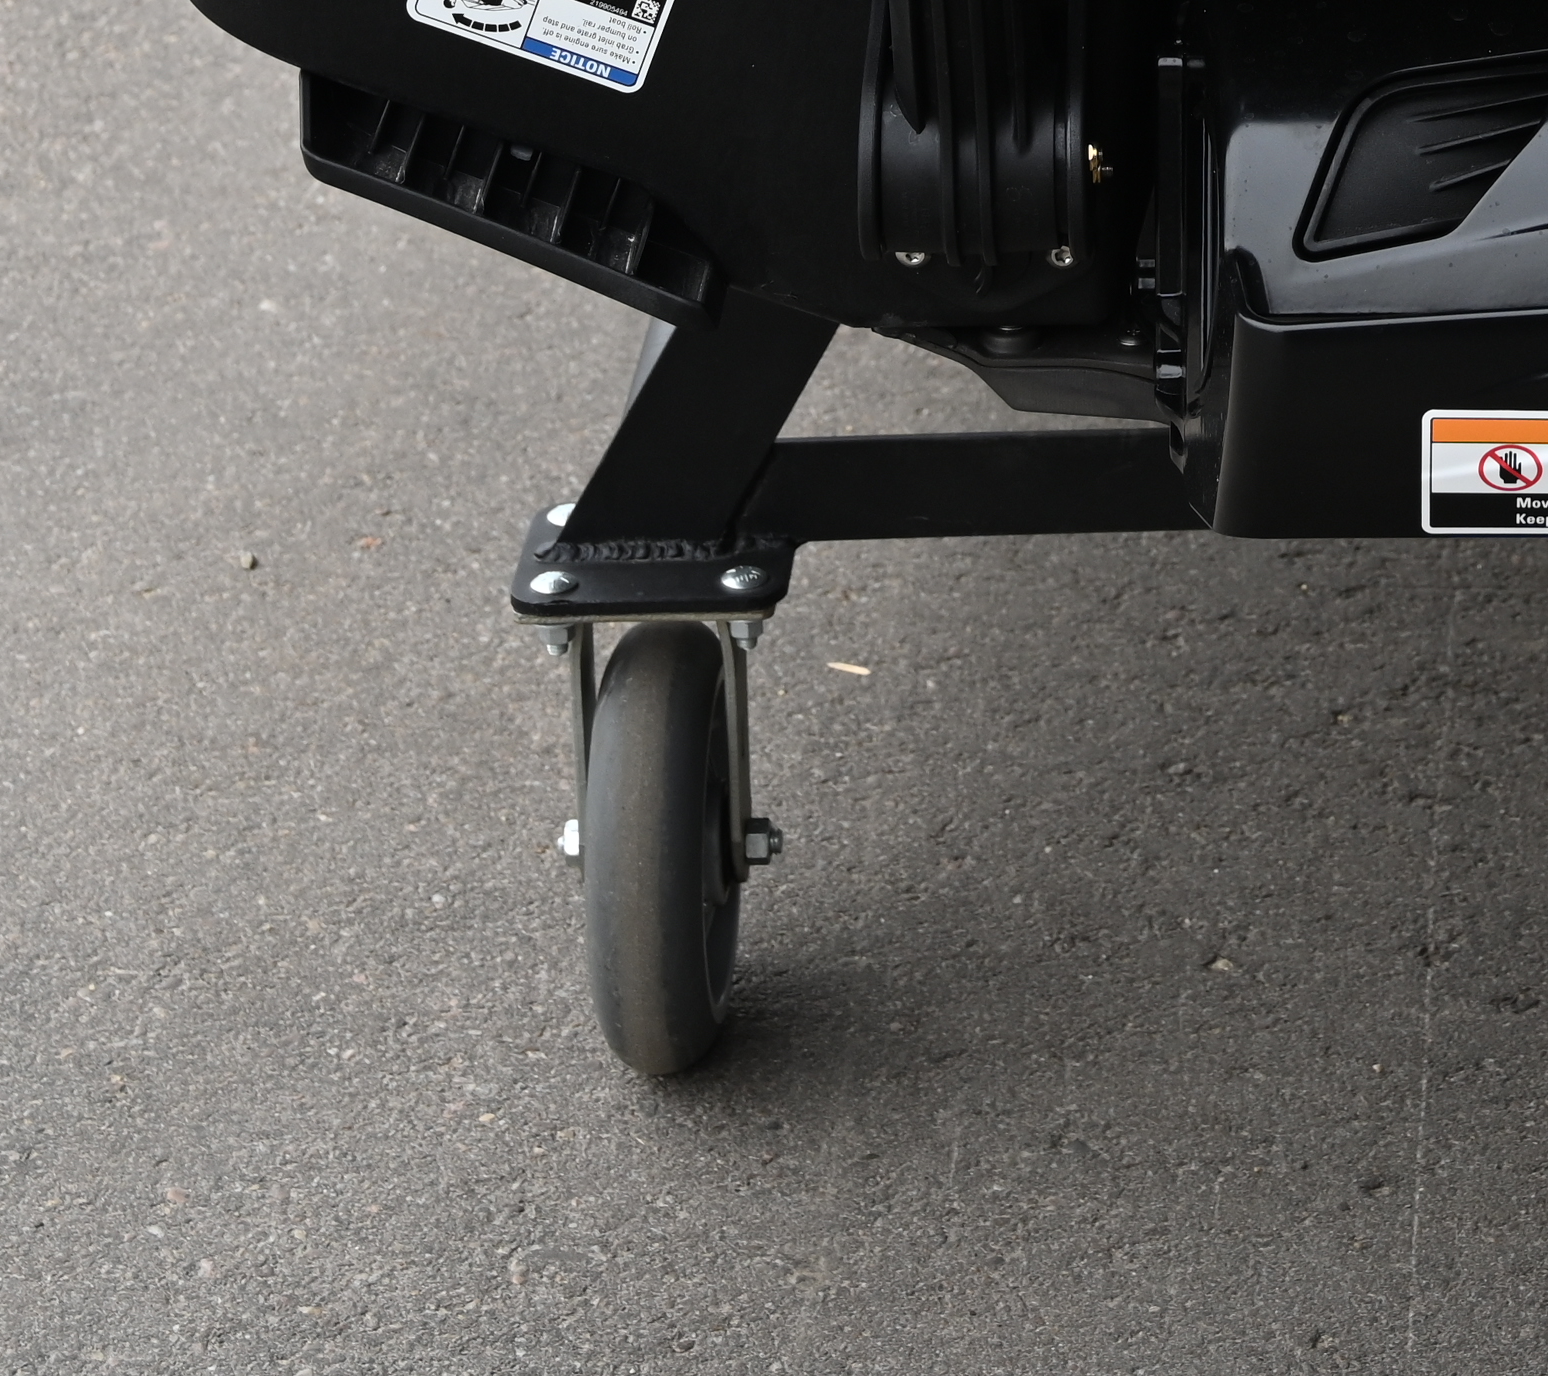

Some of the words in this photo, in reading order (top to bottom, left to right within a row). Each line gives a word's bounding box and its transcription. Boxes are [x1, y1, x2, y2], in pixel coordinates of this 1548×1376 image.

[543, 16, 559, 27] step
[609, 17, 626, 27] boat
[561, 24, 574, 32] and
[596, 26, 626, 39] bumper
[577, 30, 596, 39] grate
[597, 35, 615, 45] inlet
[564, 35, 589, 48] engine
[591, 45, 607, 54] sure
[616, 42, 635, 54] Grab
[550, 48, 611, 77] NOTICE
[609, 52, 631, 64] Make
